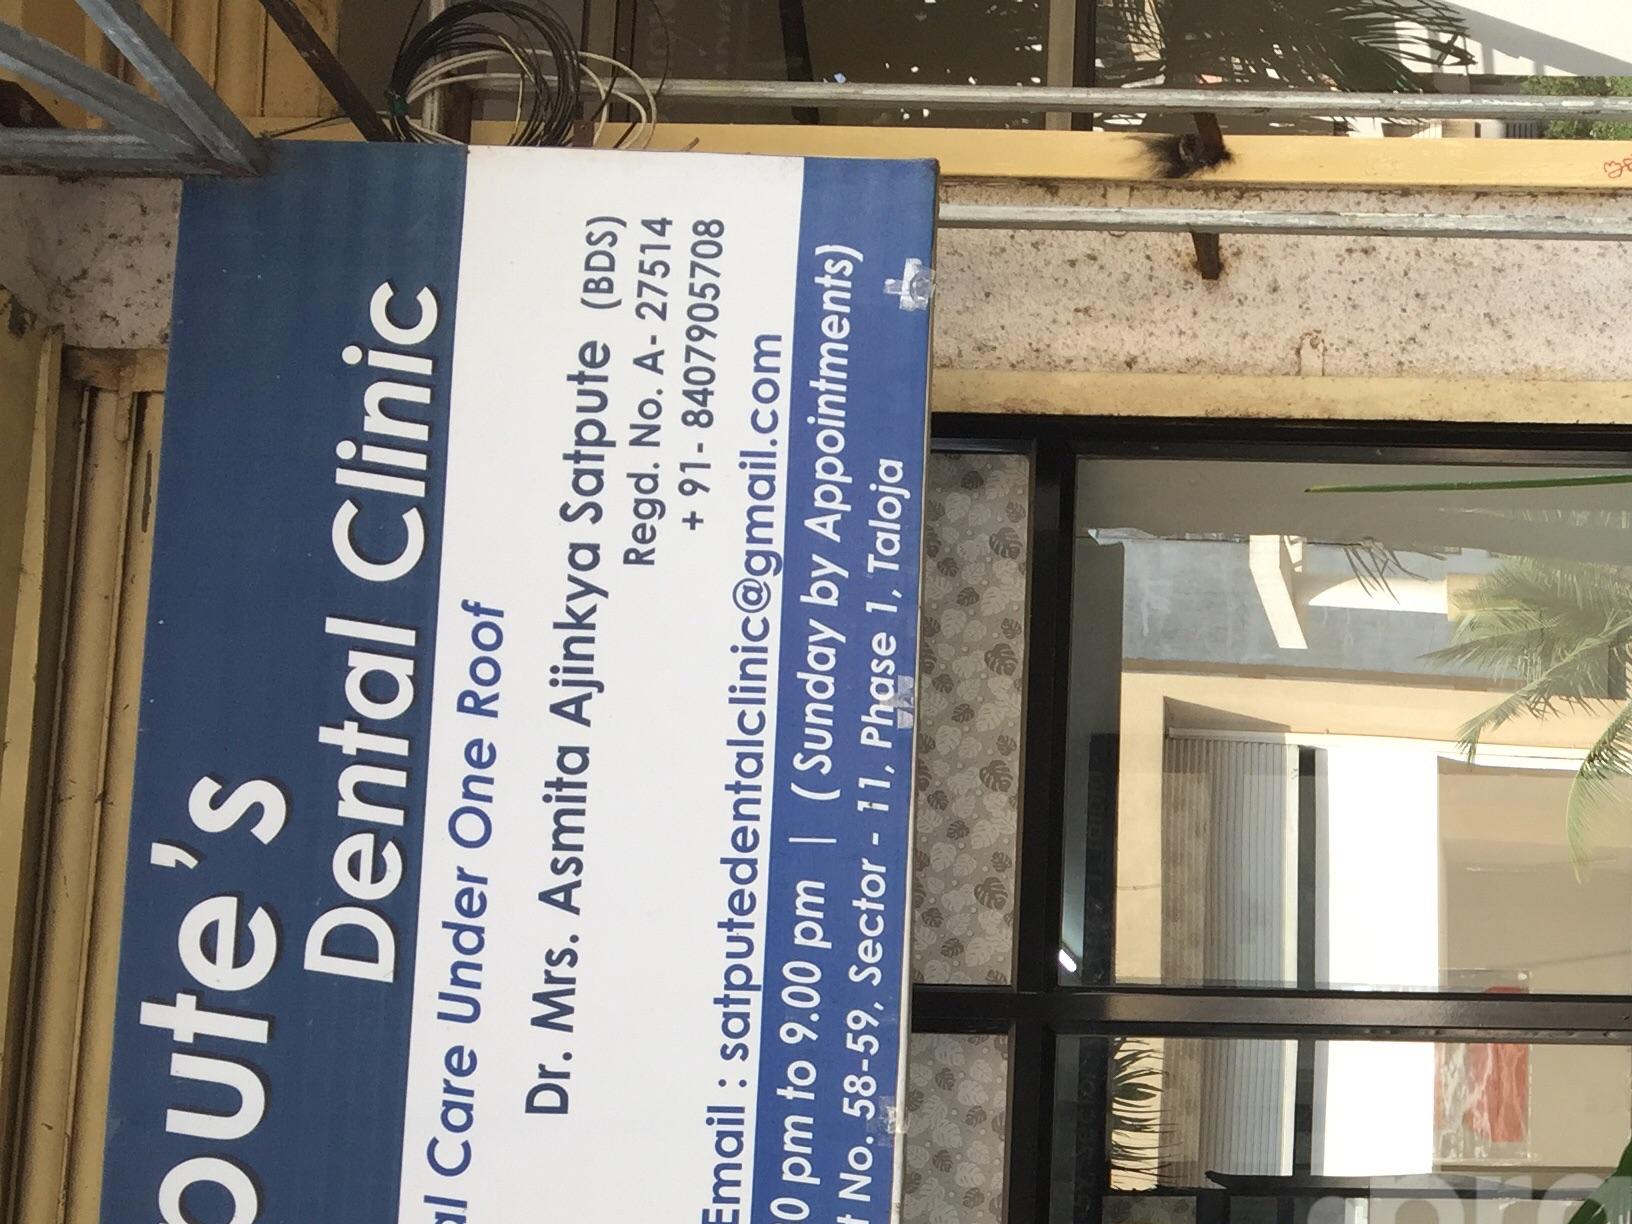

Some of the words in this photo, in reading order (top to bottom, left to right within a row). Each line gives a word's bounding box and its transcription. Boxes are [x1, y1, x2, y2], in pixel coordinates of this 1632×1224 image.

[581, 217, 626, 309] (BDS)
[636, 218, 672, 321] 27514
[682, 220, 724, 428] 8407905708
[332, 282, 437, 581] Clinic
[560, 341, 616, 524] Satpute
[629, 389, 662, 446] No.
[804, 245, 863, 542] Appointments)
[623, 463, 665, 565] Regd.
[868, 459, 910, 573] Taloja
[549, 543, 608, 726] Ajinkya
[800, 554, 848, 606] by
[866, 590, 902, 612] 1,
[457, 600, 504, 718] Roof
[714, 335, 781, 1061] satputedentalclinic@gmail.com
[861, 632, 896, 748] Phase
[304, 617, 415, 982] Dental
[448, 739, 496, 848] One
[538, 746, 589, 915] Asmita
[437, 866, 488, 1023] Under
[794, 881, 832, 948] pm
[849, 858, 886, 986] Sector
[531, 935, 579, 1032] Mrs.
[780, 961, 821, 1044] 9.00
[427, 1046, 477, 1176] Care
[525, 1052, 572, 1114] Dr.
[777, 1061, 816, 1099] to
[843, 1002, 883, 1120] 58-59,
[782, 1116, 820, 1184] pm
[839, 1137, 873, 1201] No.
